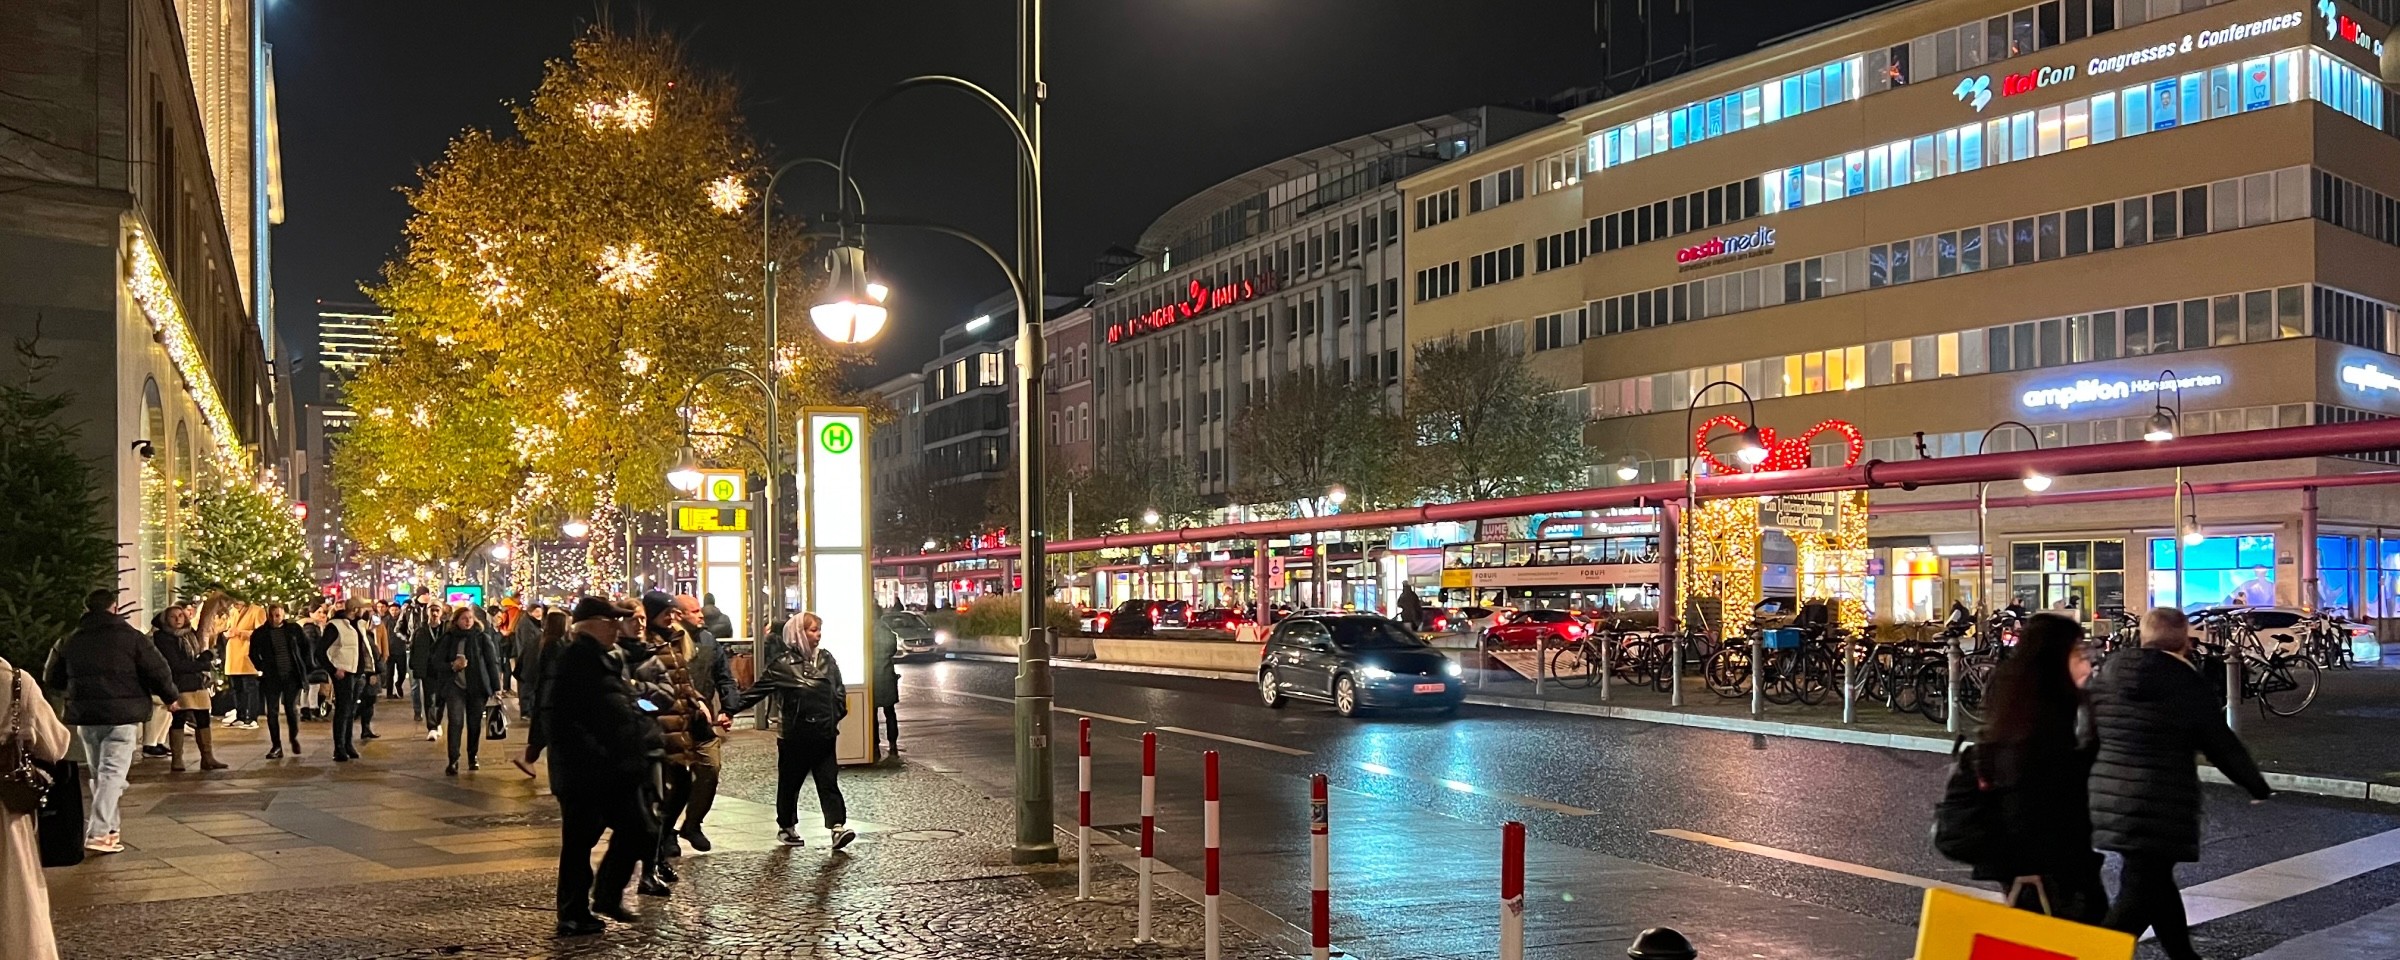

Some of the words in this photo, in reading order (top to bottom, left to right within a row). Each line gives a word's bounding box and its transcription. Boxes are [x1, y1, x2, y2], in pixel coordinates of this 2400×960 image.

[2002, 64, 2076, 97] KelCon
[2087, 44, 2177, 76] Congresses
[2179, 34, 2193, 54] &
[2197, 10, 2303, 49] Conferences
[1676, 225, 1776, 264] aesthmedic
[2023, 378, 2130, 410] amplifon
[1763, 501, 1777, 512] Ein
[1777, 498, 1822, 515] Unternehmen
[1822, 502, 1835, 516] der
